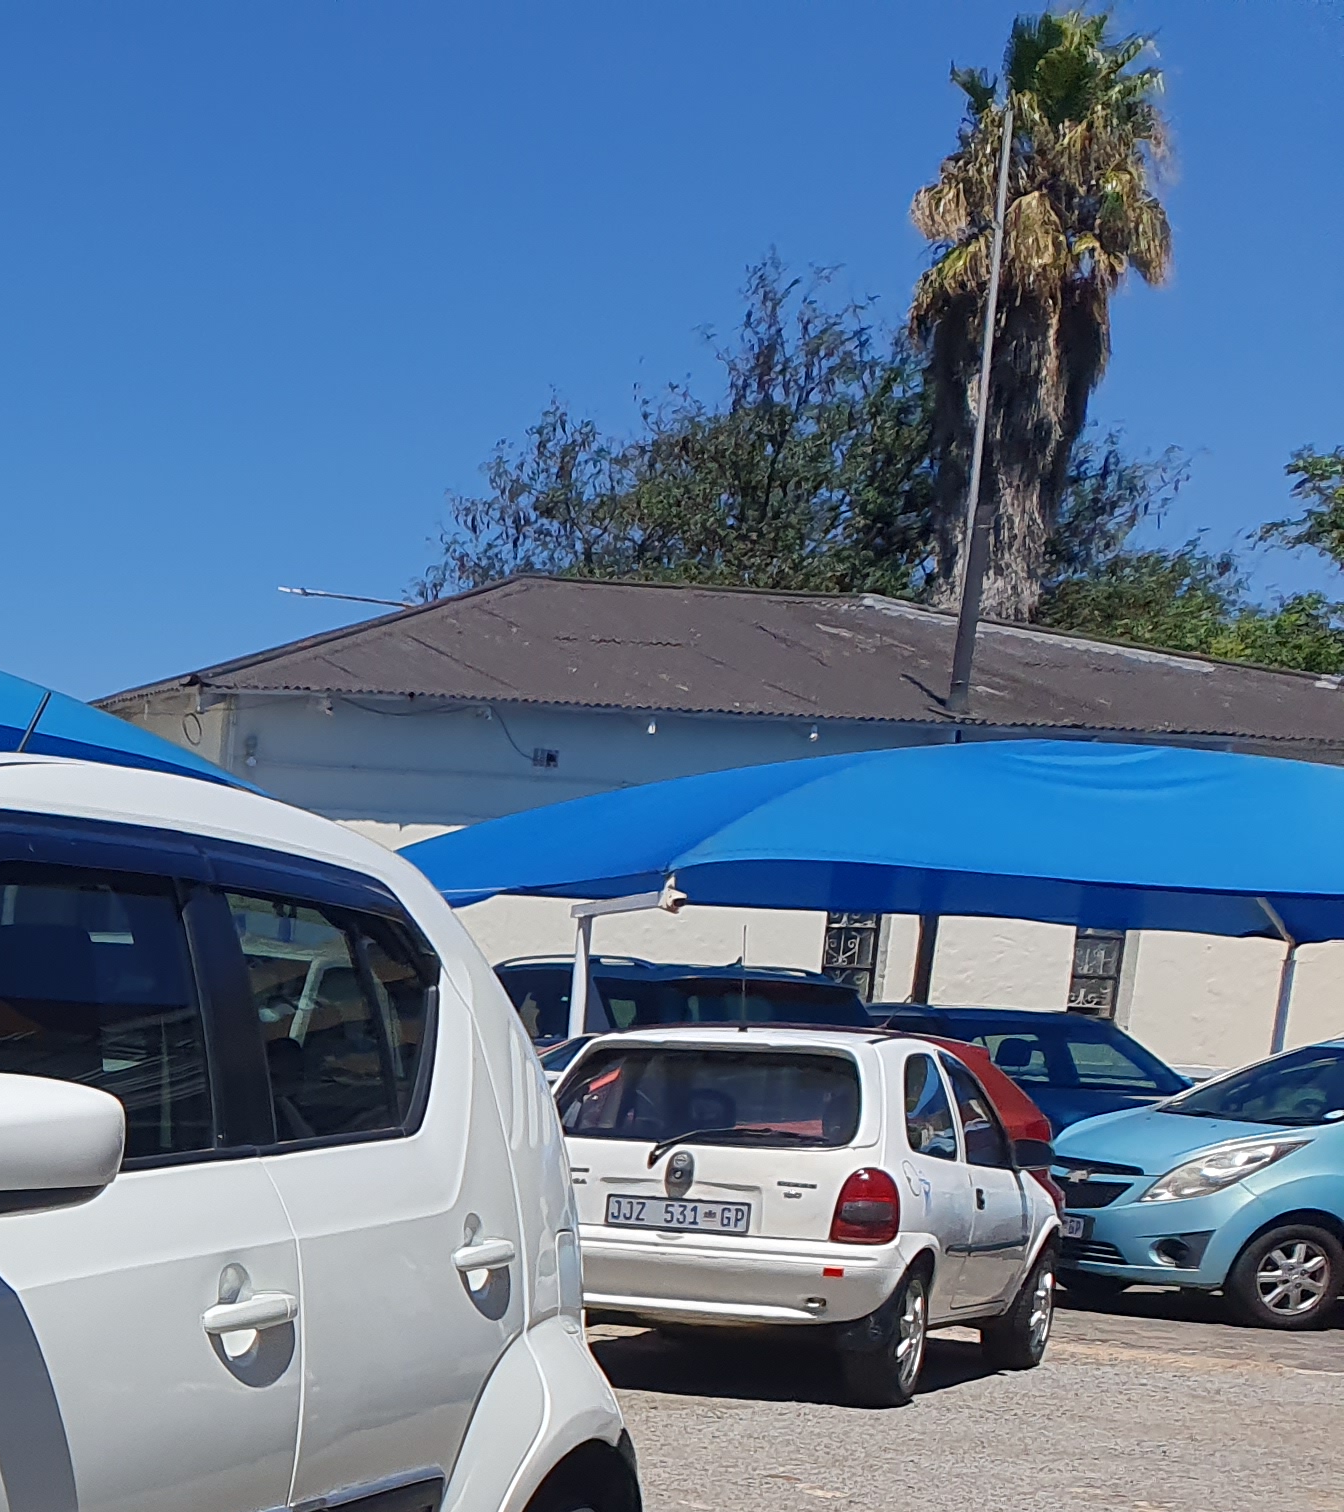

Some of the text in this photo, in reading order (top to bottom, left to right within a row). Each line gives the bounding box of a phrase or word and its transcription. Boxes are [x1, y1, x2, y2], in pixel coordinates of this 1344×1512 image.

[611, 1200, 745, 1227] JJZ 531 GP
